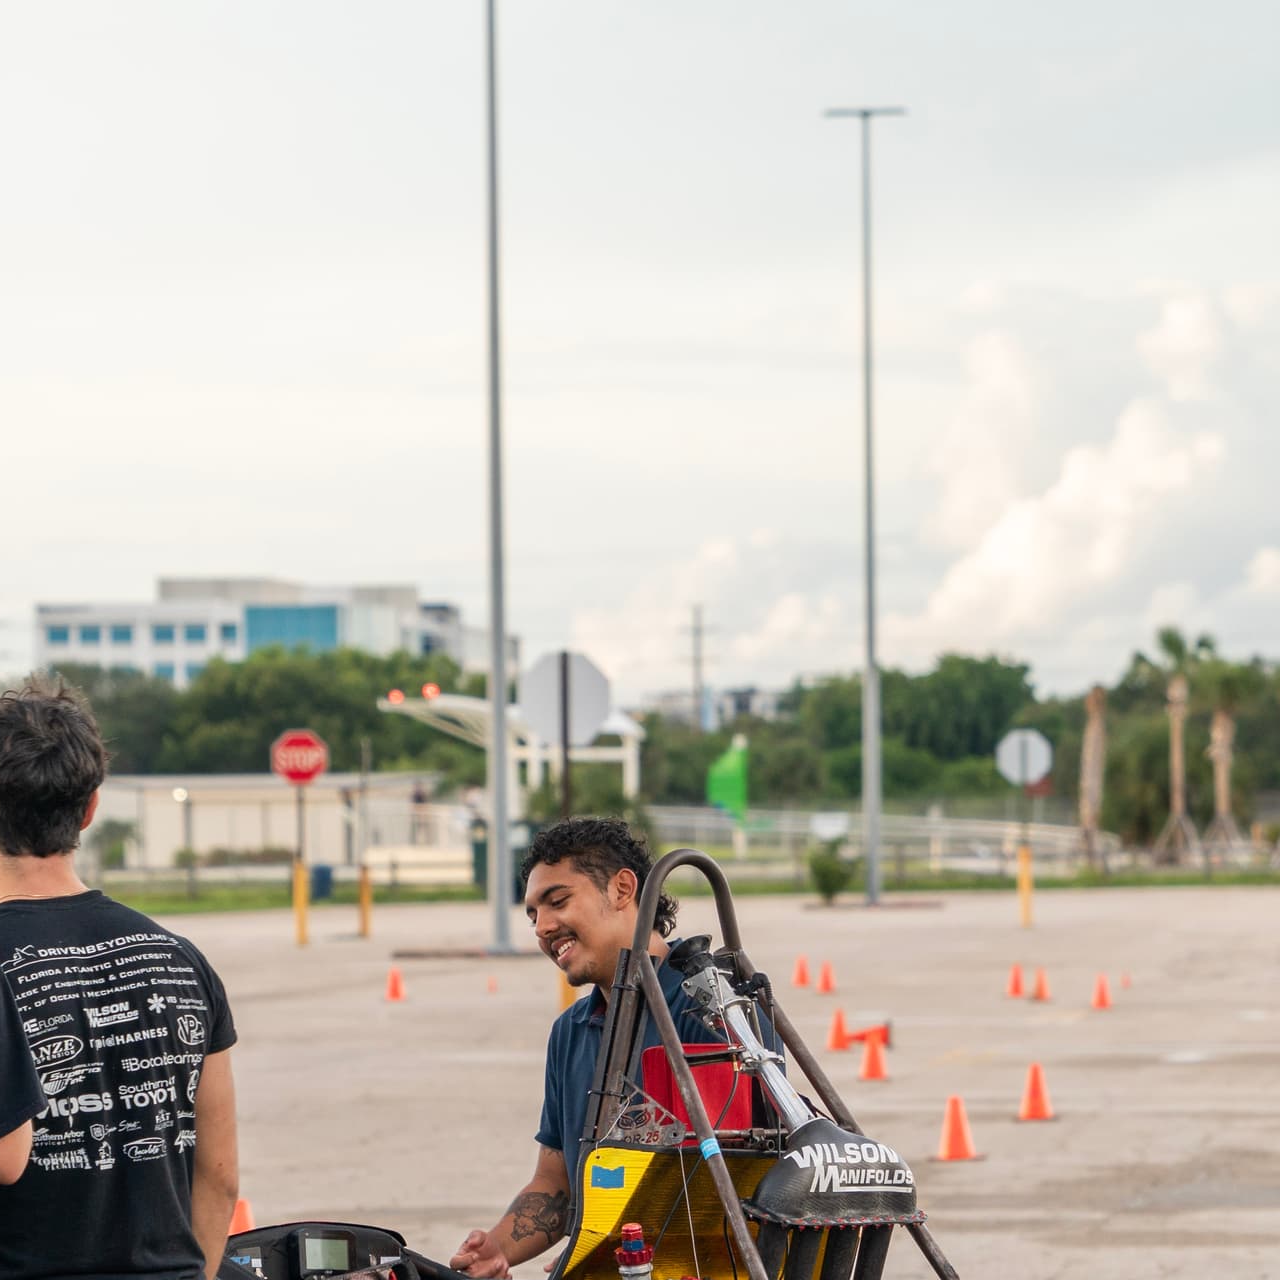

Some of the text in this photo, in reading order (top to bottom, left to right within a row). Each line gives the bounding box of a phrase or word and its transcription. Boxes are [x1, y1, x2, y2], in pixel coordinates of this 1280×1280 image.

[17, 968, 62, 984] FLORIDA
[783, 1143, 900, 1168] WILSON
[809, 1165, 914, 1193] MANIFOLDS
